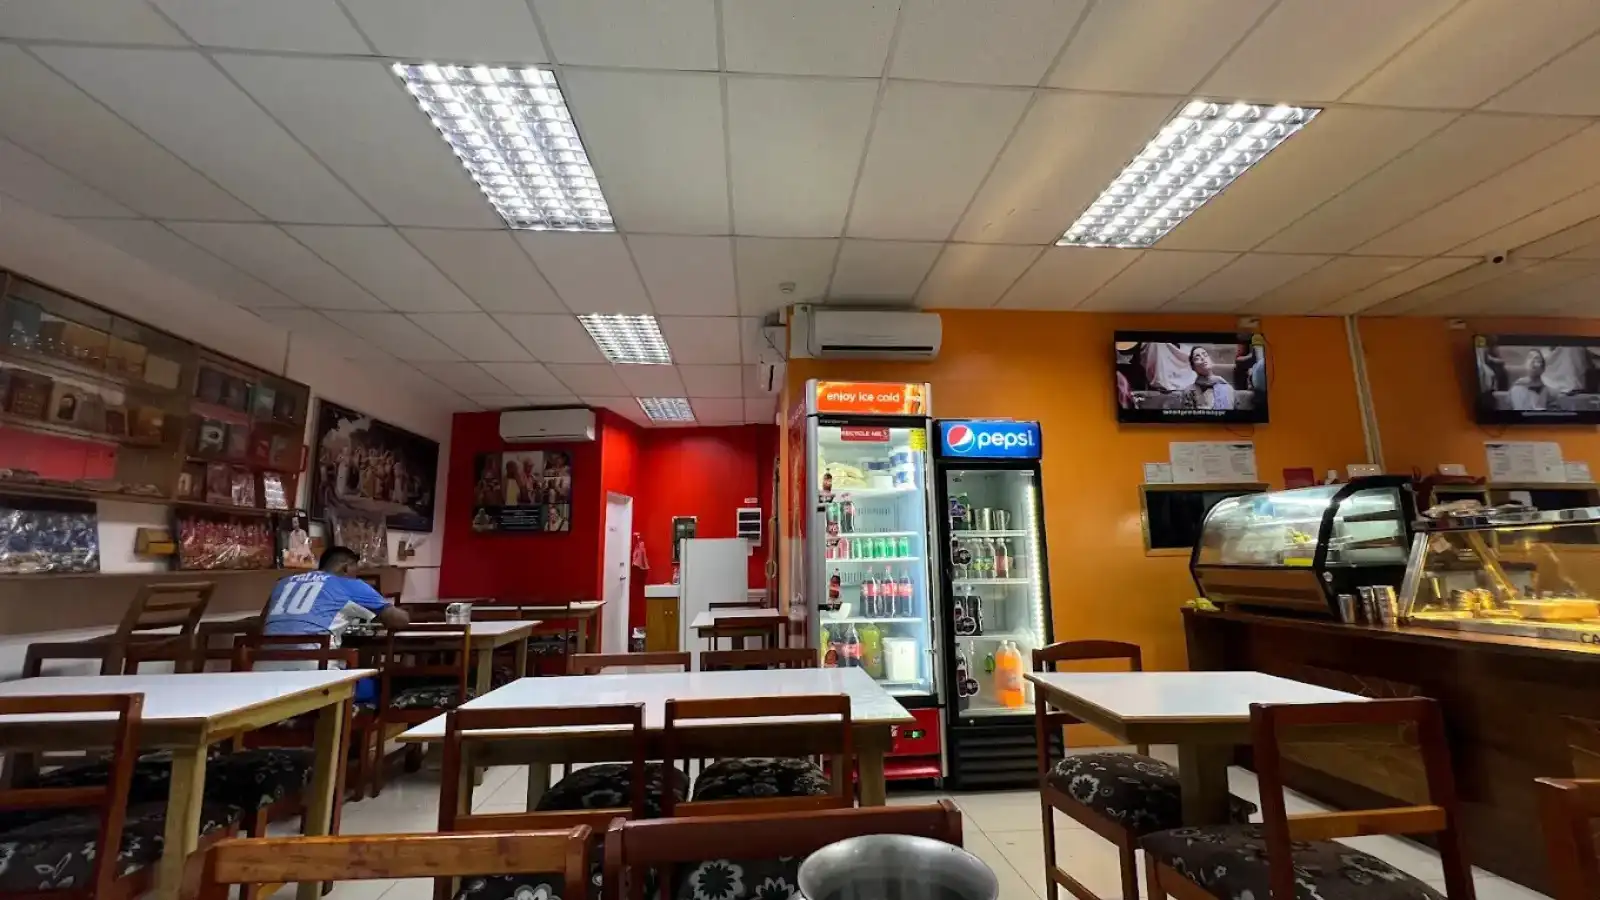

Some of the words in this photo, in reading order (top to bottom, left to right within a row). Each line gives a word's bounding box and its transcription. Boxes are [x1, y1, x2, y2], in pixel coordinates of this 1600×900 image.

[826, 391, 856, 403] enjoy
[858, 391, 875, 402] ice
[876, 392, 900, 403] cold
[977, 429, 1034, 450] pepsi
[270, 581, 325, 616] 10
